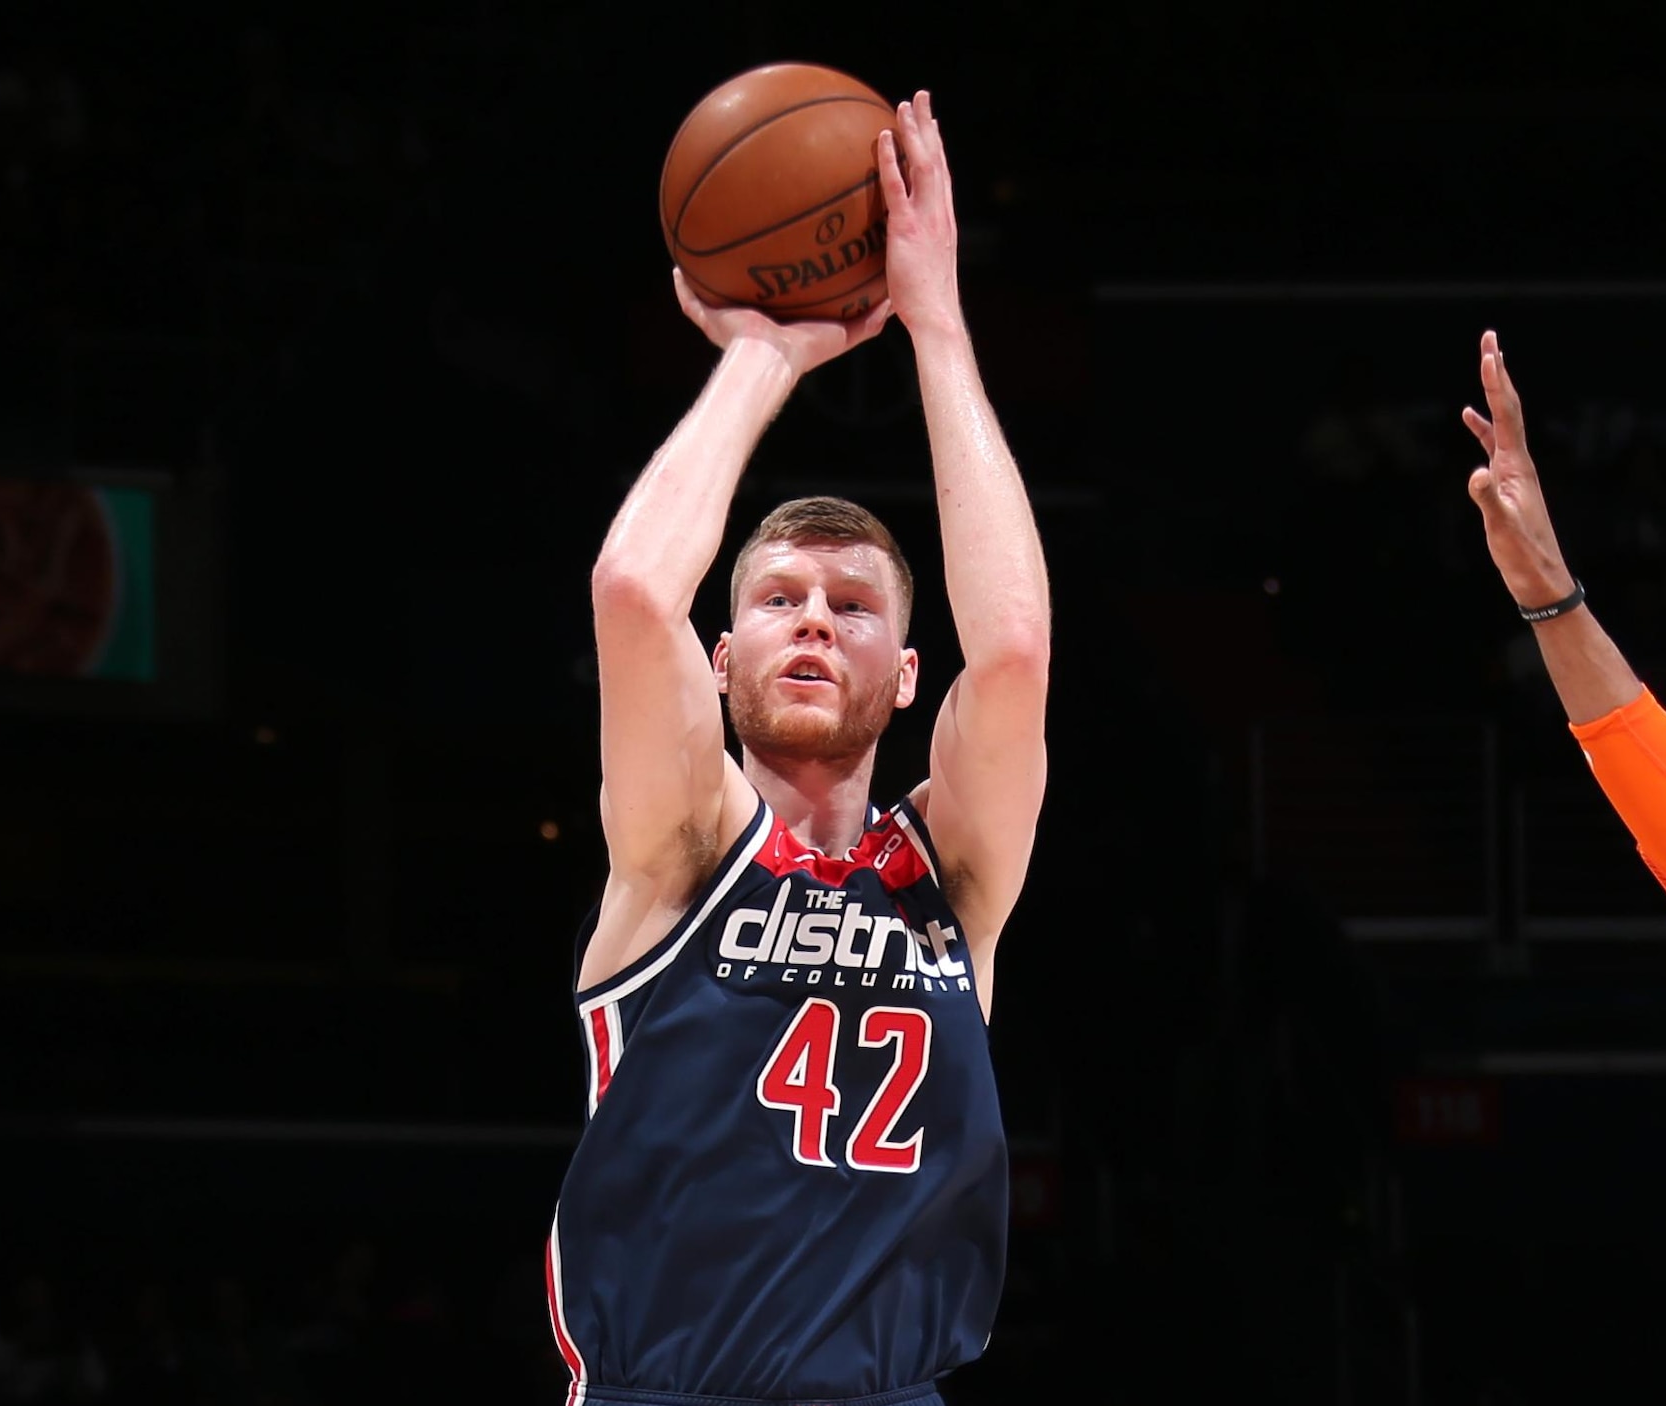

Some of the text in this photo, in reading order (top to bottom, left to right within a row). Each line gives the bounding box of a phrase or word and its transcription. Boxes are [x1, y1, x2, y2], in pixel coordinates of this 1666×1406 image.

[805, 889, 847, 910] THE
[716, 962, 971, 992] OF COLUMBIA
[756, 997, 932, 1174] 42
